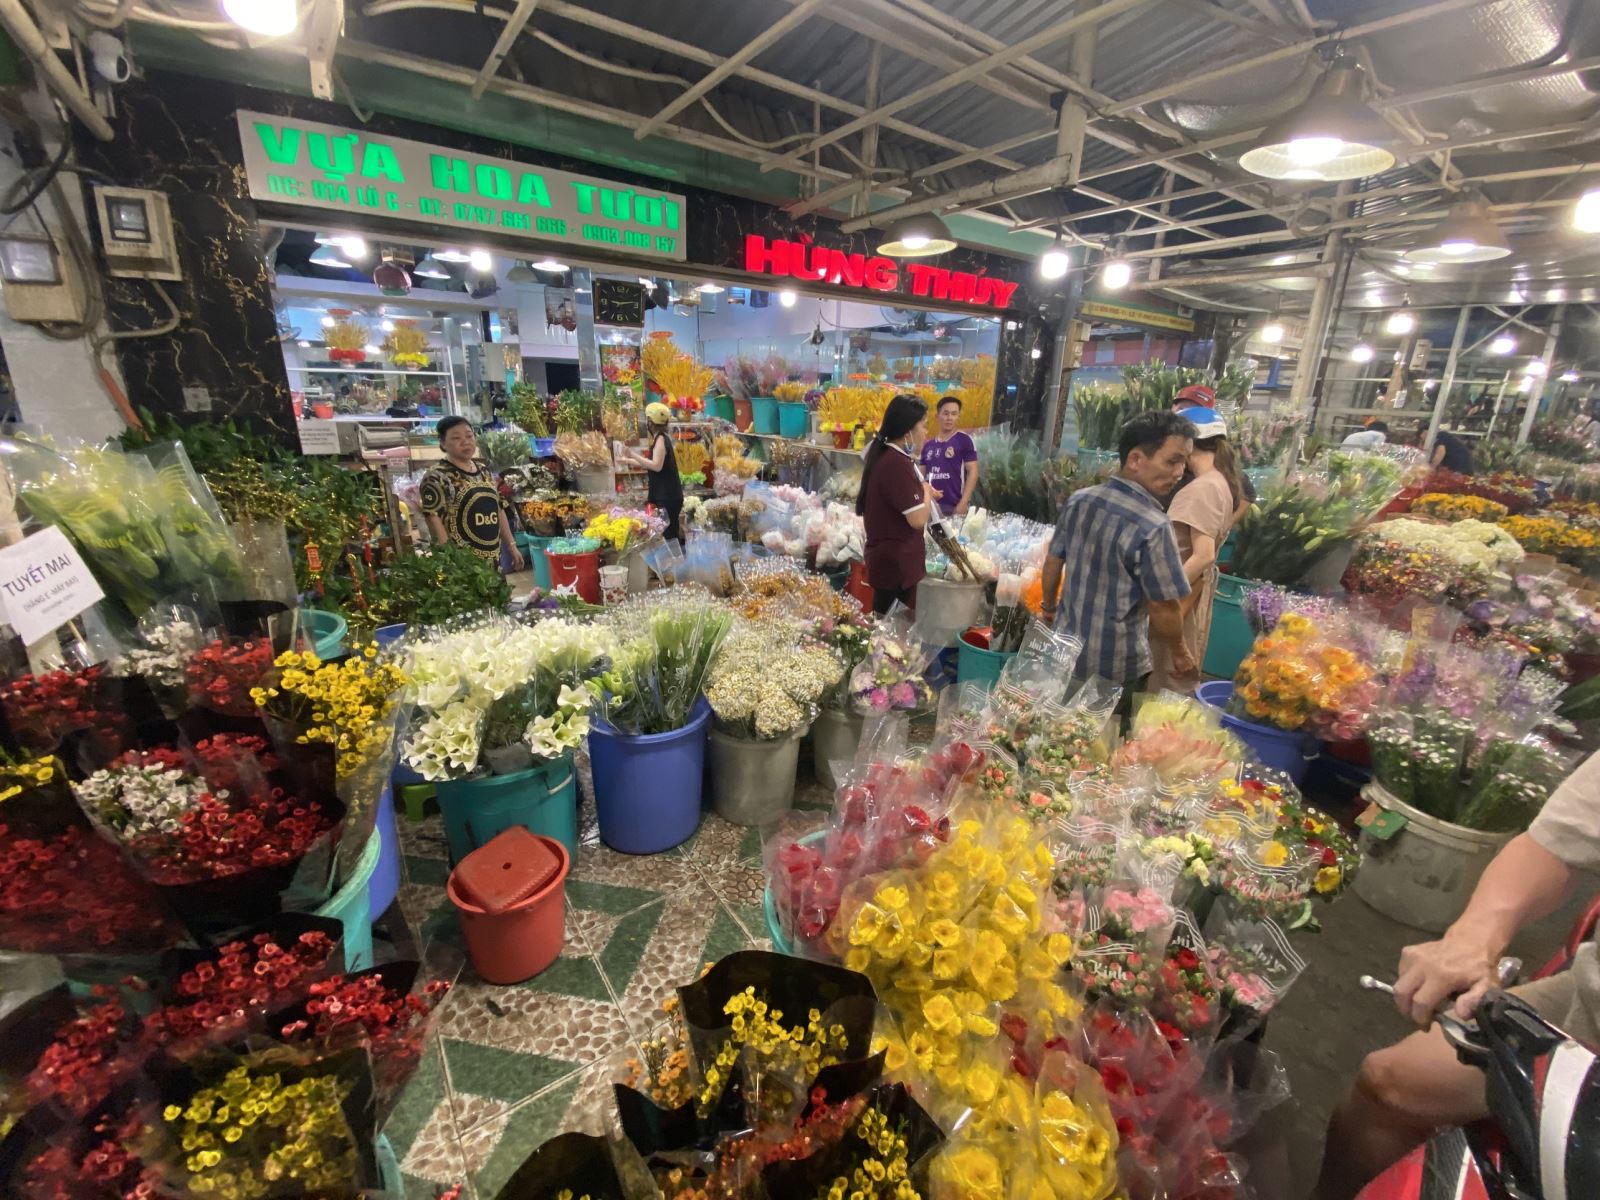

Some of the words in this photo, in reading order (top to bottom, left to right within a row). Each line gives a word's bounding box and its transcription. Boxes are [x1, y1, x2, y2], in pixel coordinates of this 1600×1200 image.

[252, 121, 405, 183] VỰA
[429, 153, 552, 208] HOA
[569, 181, 679, 231] TƯƠI
[385, 191, 399, 211] C
[746, 232, 898, 291] HÙNG
[906, 262, 1019, 309] THÚY
[475, 512, 498, 526] D&G
[3, 564, 46, 597] TUYẾT
[45, 553, 71, 576] MAI
